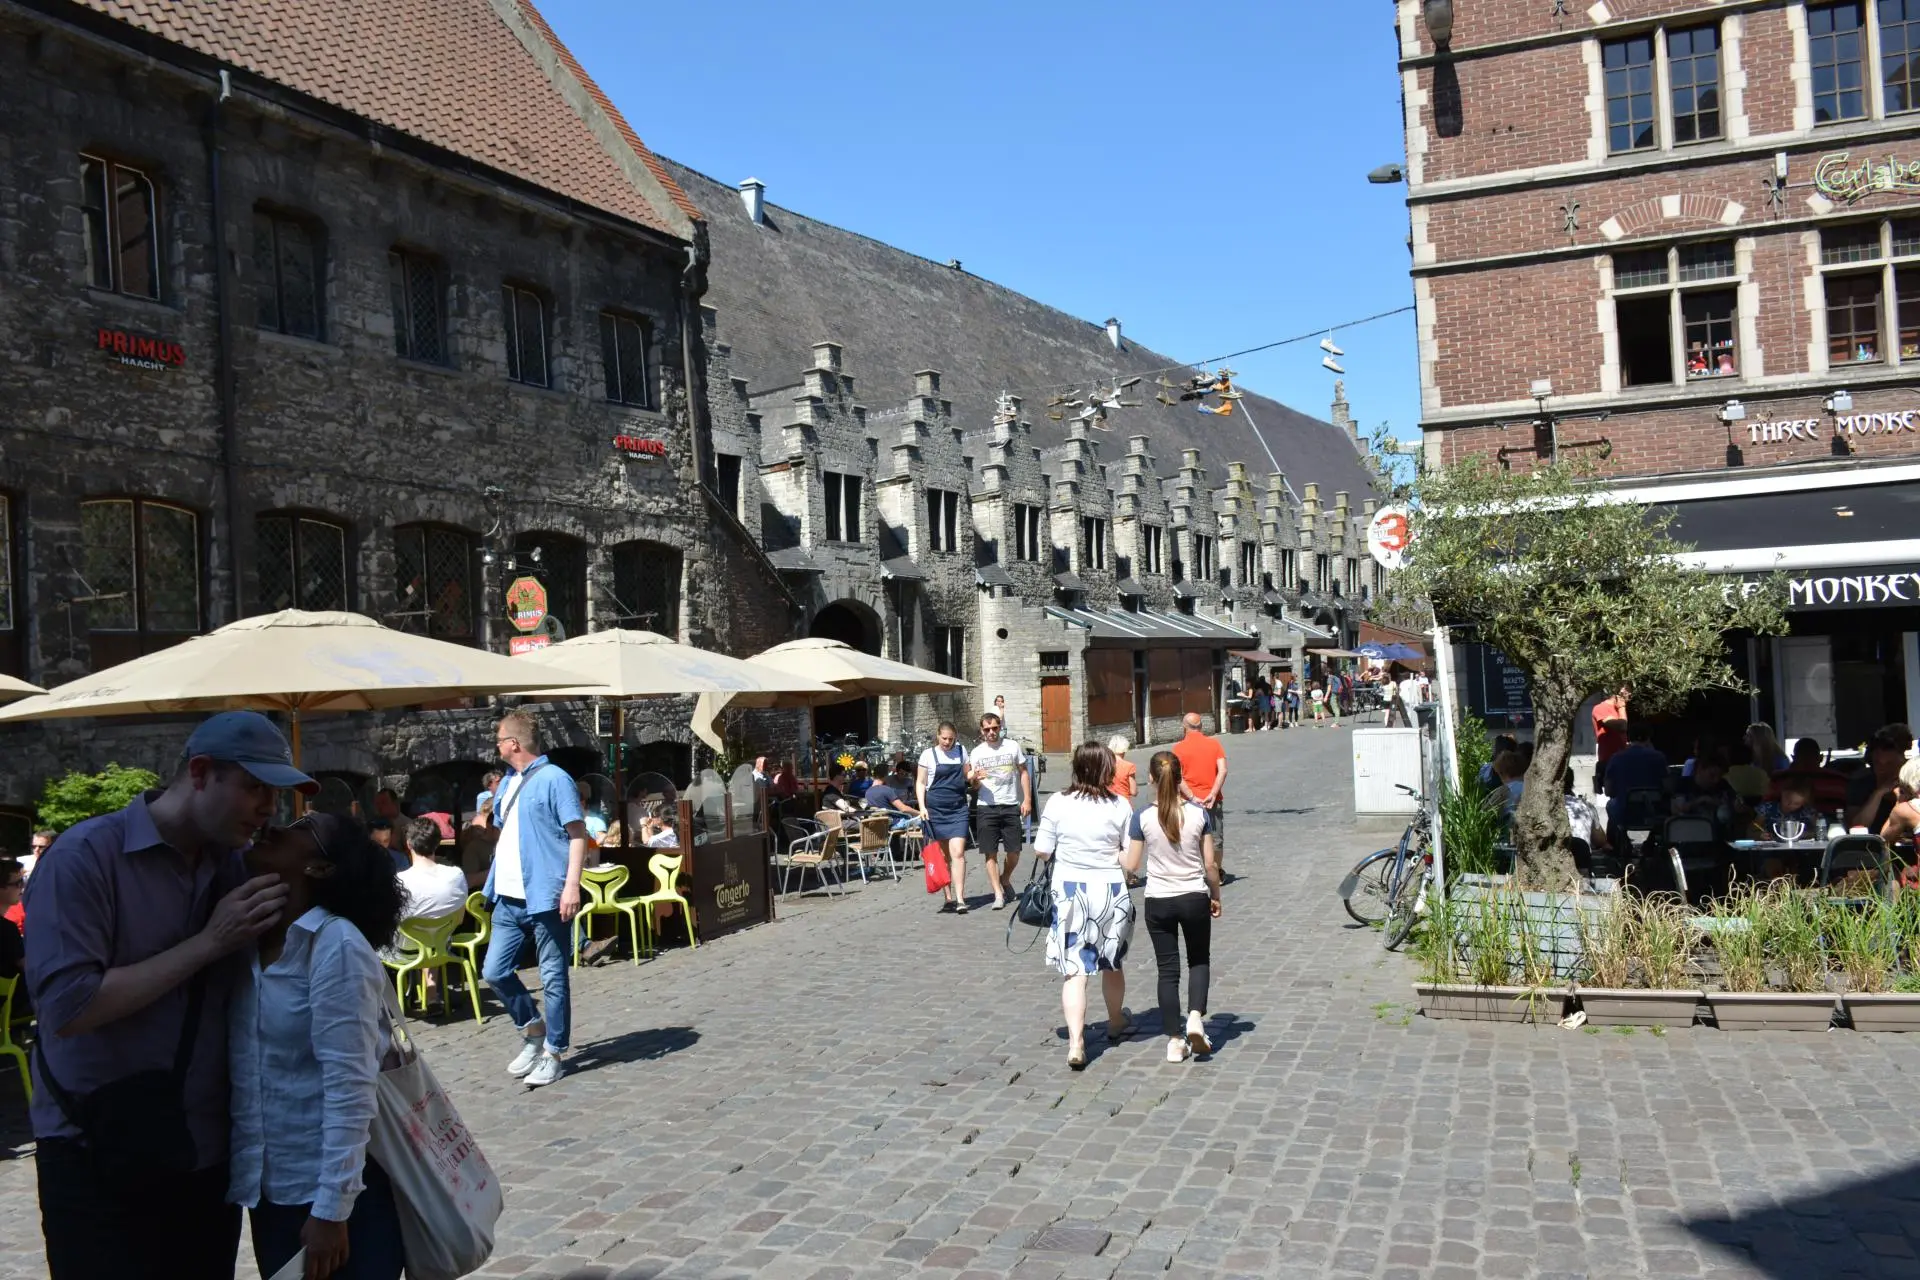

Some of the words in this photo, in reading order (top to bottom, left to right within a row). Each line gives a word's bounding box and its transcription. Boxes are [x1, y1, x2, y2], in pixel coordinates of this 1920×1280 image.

[98, 328, 186, 366] PRIMUS
[121, 356, 165, 371] HAACHT
[1747, 418, 1820, 444] THREE
[1836, 409, 1920, 436] MONKE
[615, 434, 665, 456] PRIMUS
[629, 452, 654, 460] HAACHT
[513, 609, 543, 620] PRIMUS
[714, 880, 750, 909] Tongerlo
